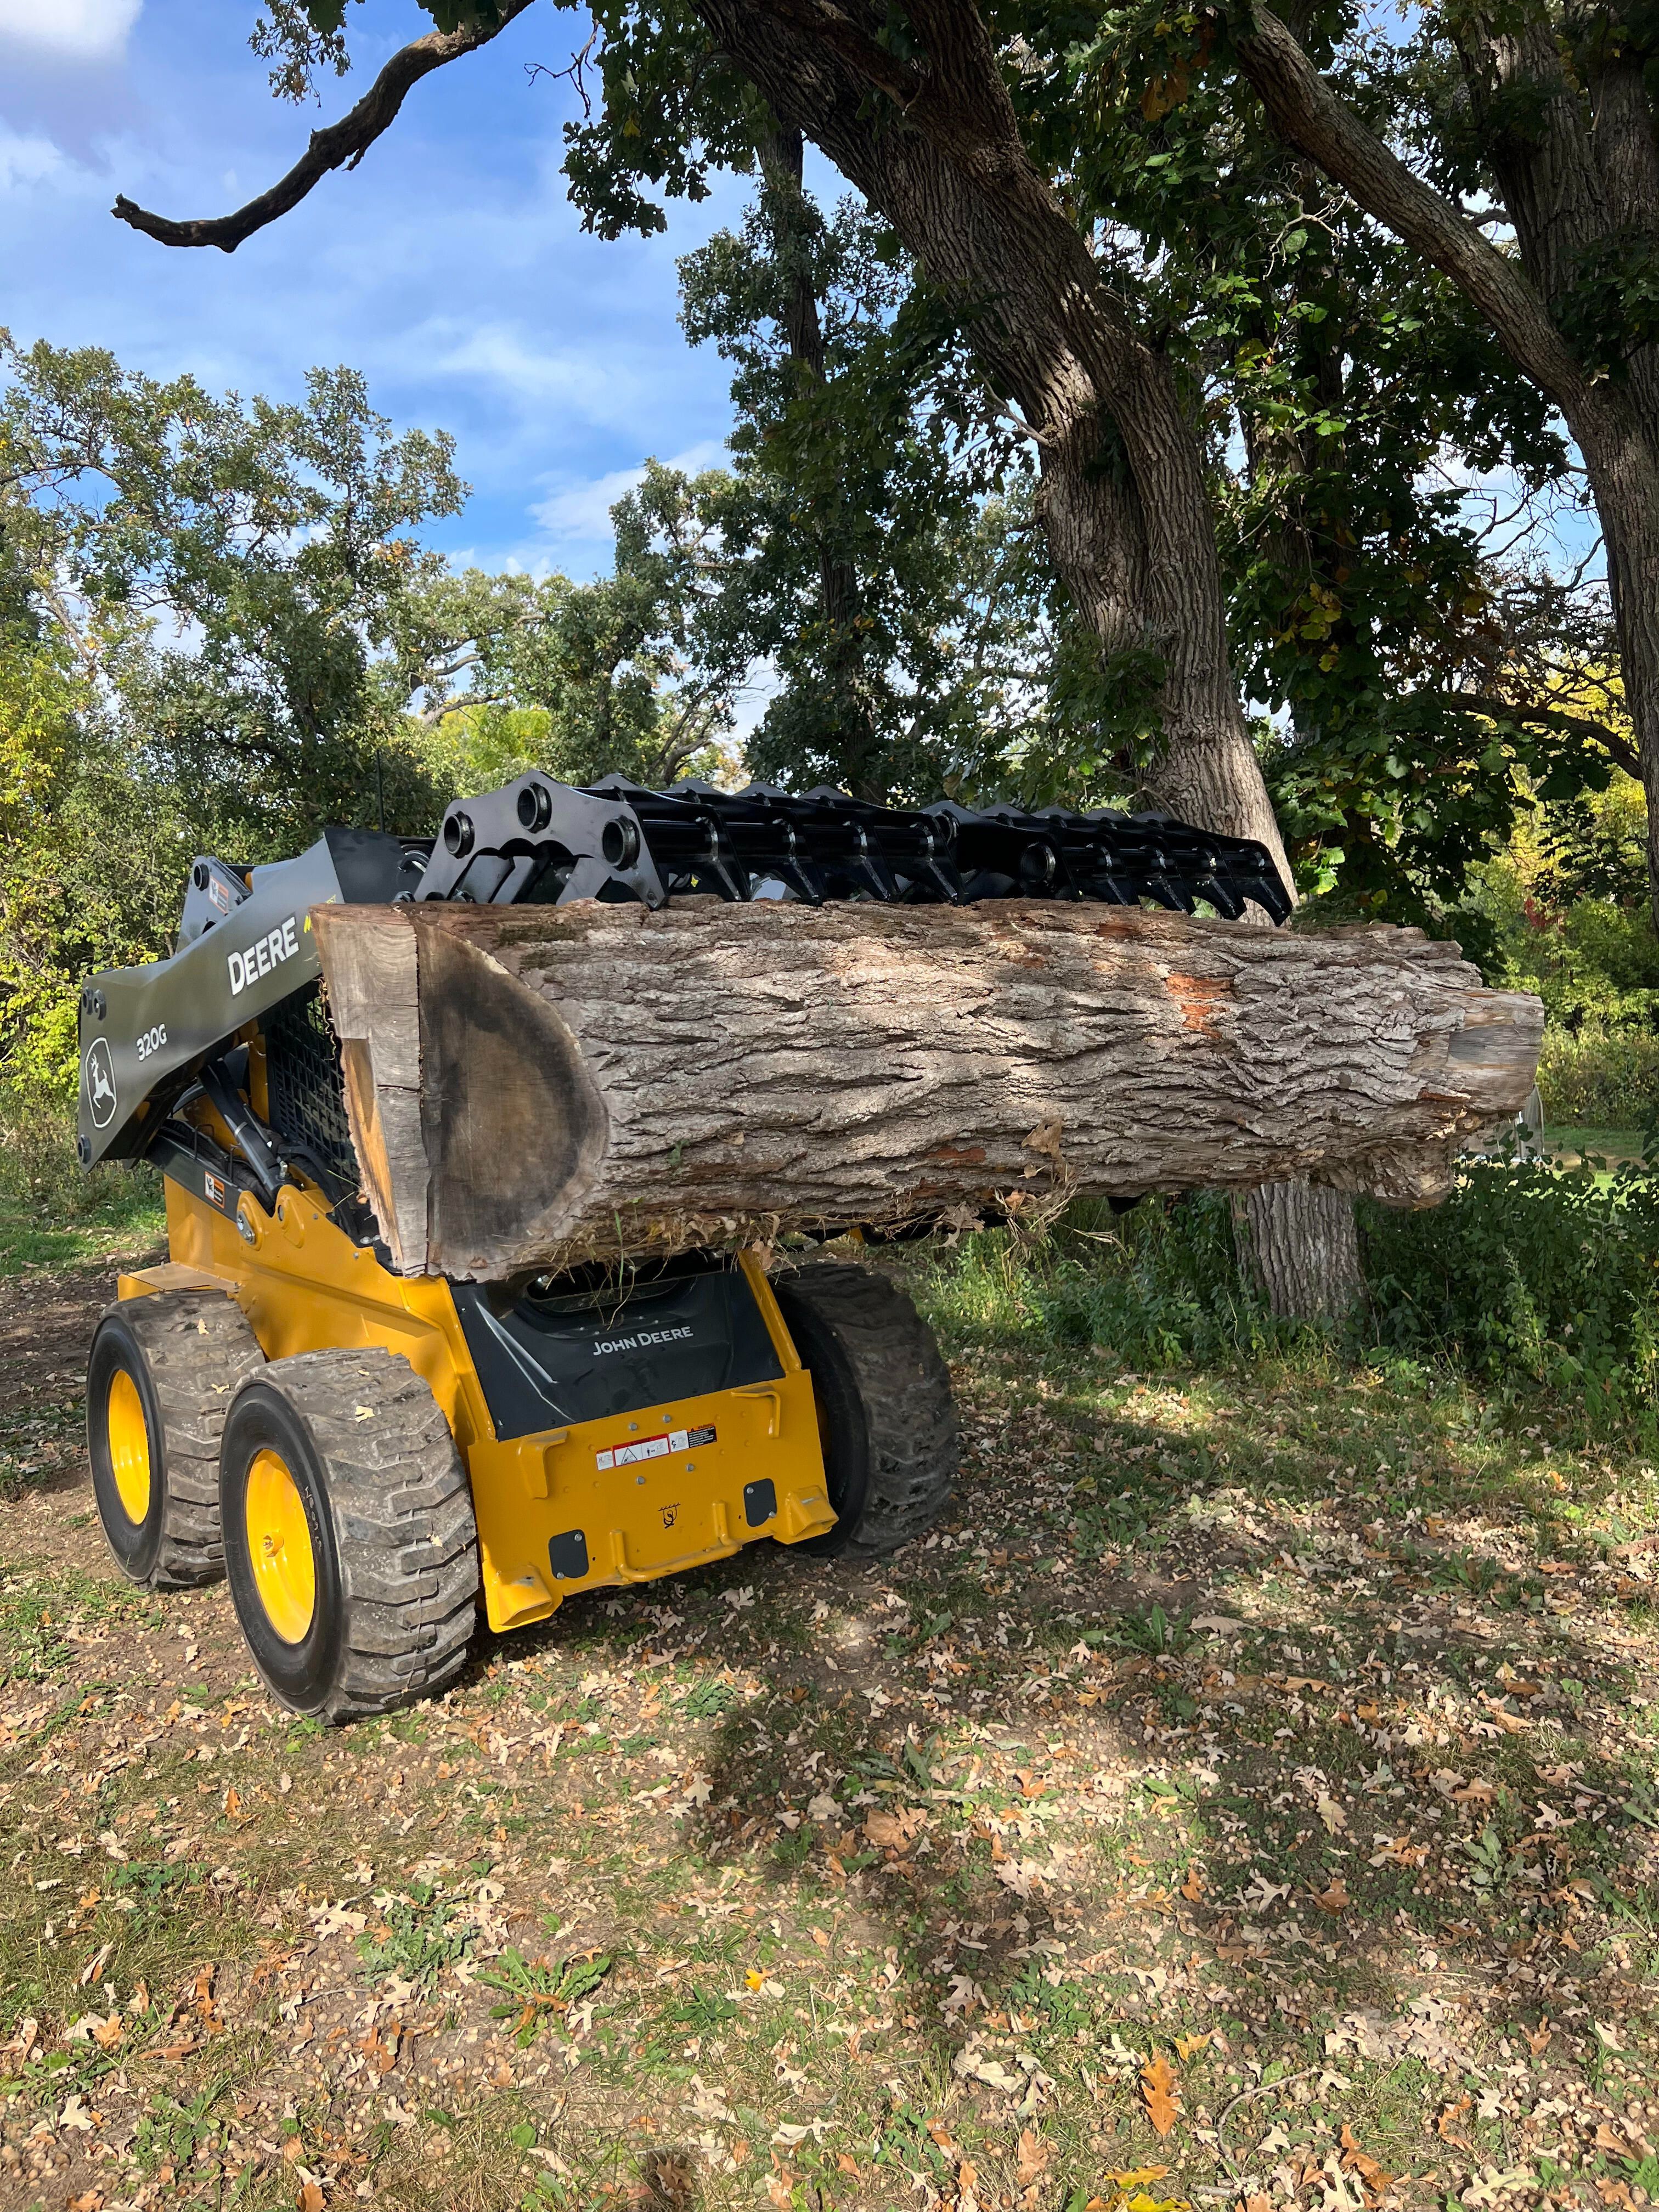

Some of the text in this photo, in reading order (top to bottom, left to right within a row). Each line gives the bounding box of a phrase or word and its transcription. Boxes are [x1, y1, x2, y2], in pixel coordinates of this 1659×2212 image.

[227, 916, 300, 996] DEERE
[136, 1023, 167, 1061] 320G
[593, 1326, 694, 1356] JOHN DEERE
